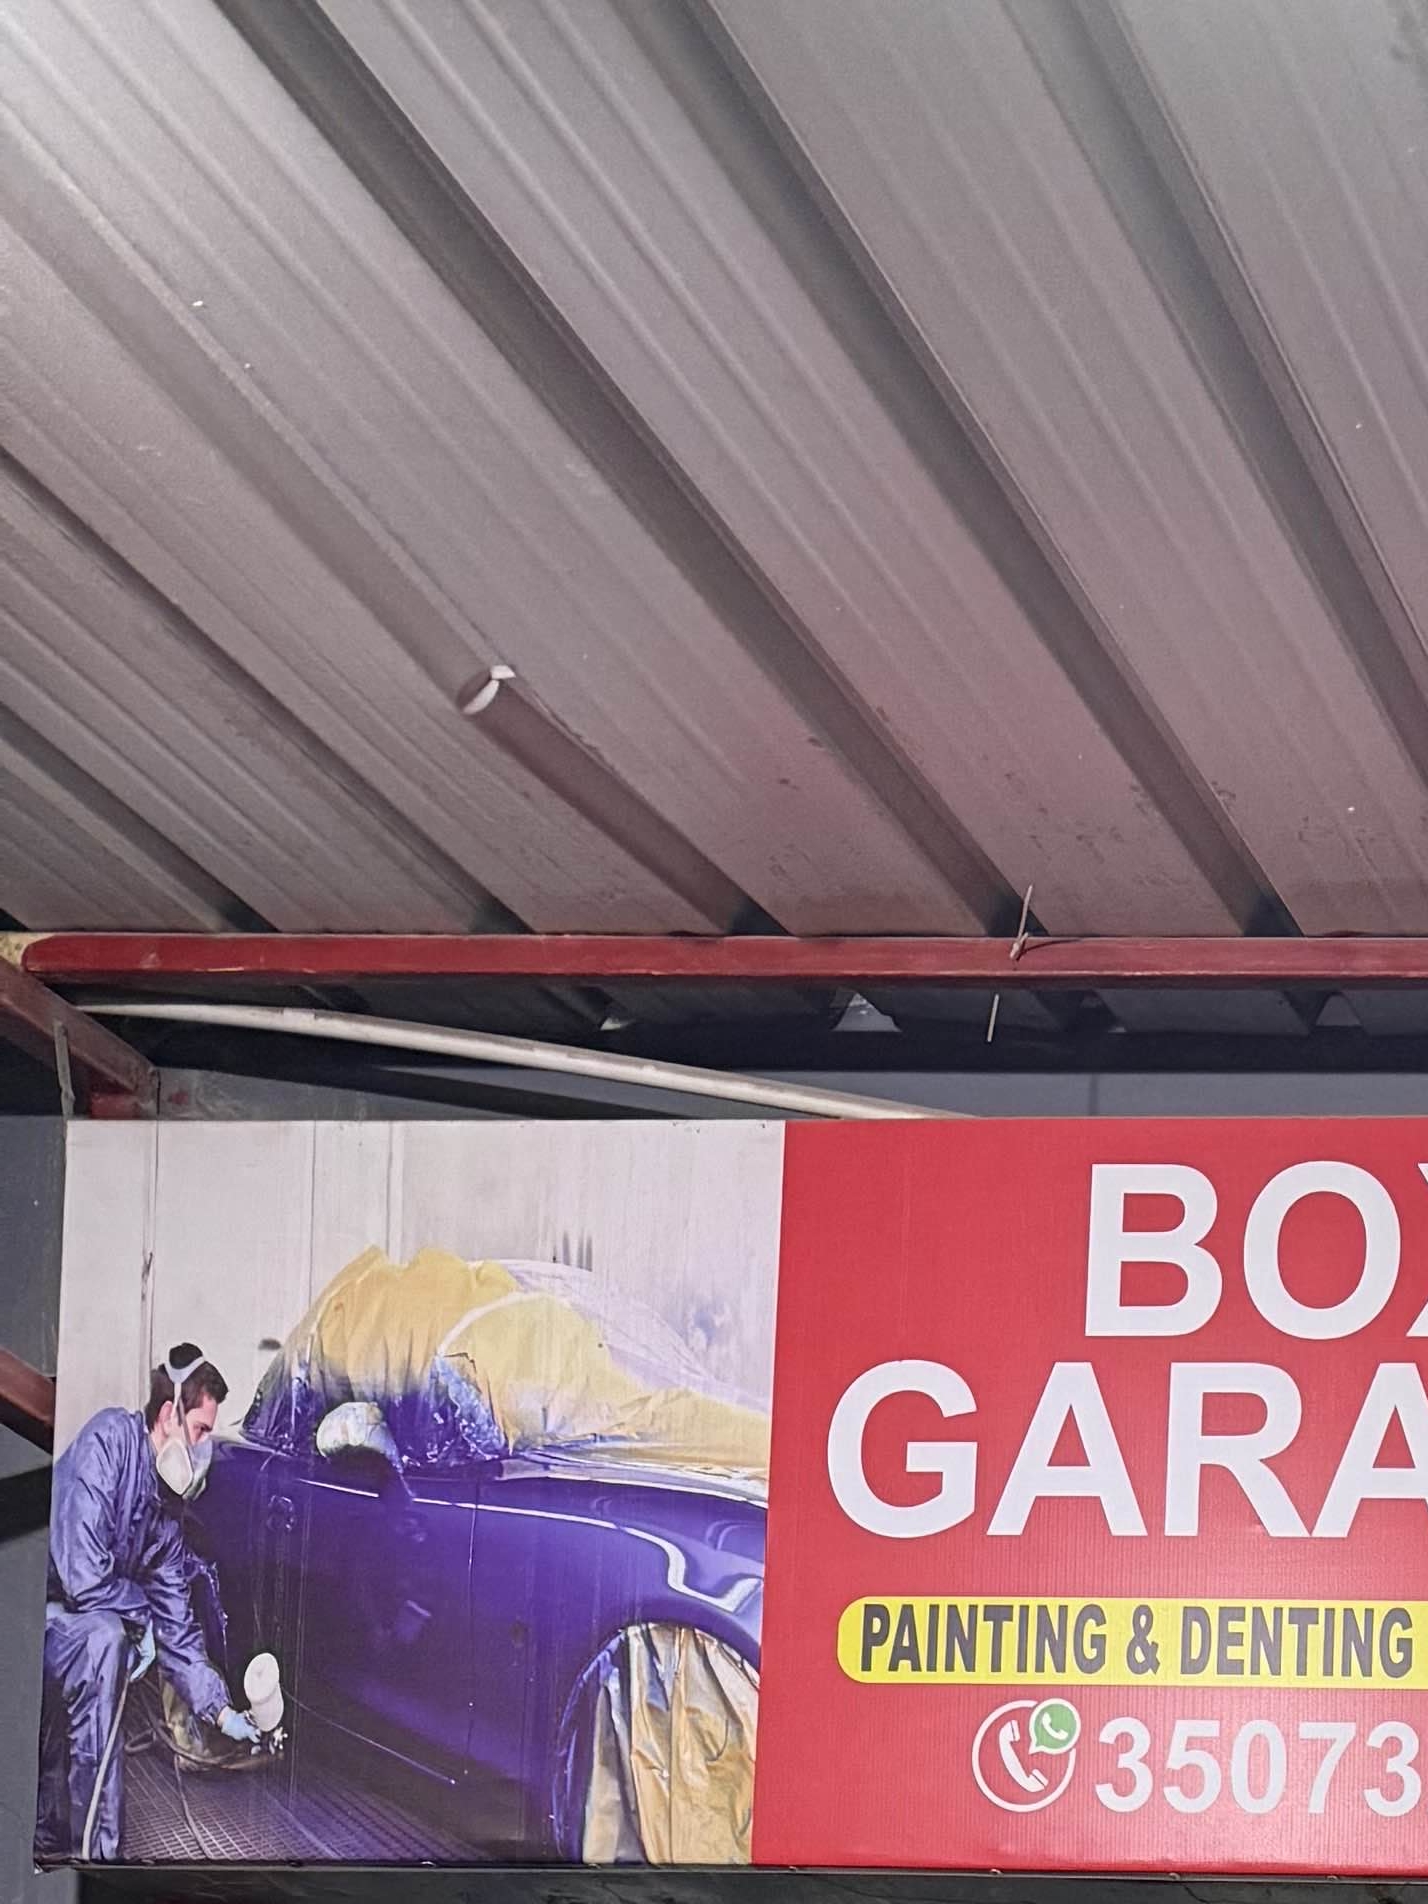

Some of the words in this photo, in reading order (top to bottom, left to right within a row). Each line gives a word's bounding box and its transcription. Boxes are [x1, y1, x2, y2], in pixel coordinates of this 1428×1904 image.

[861, 1603, 1107, 1674] PAINTING
[1125, 1604, 1161, 1675] &
[1180, 1606, 1413, 1679] DENTING
